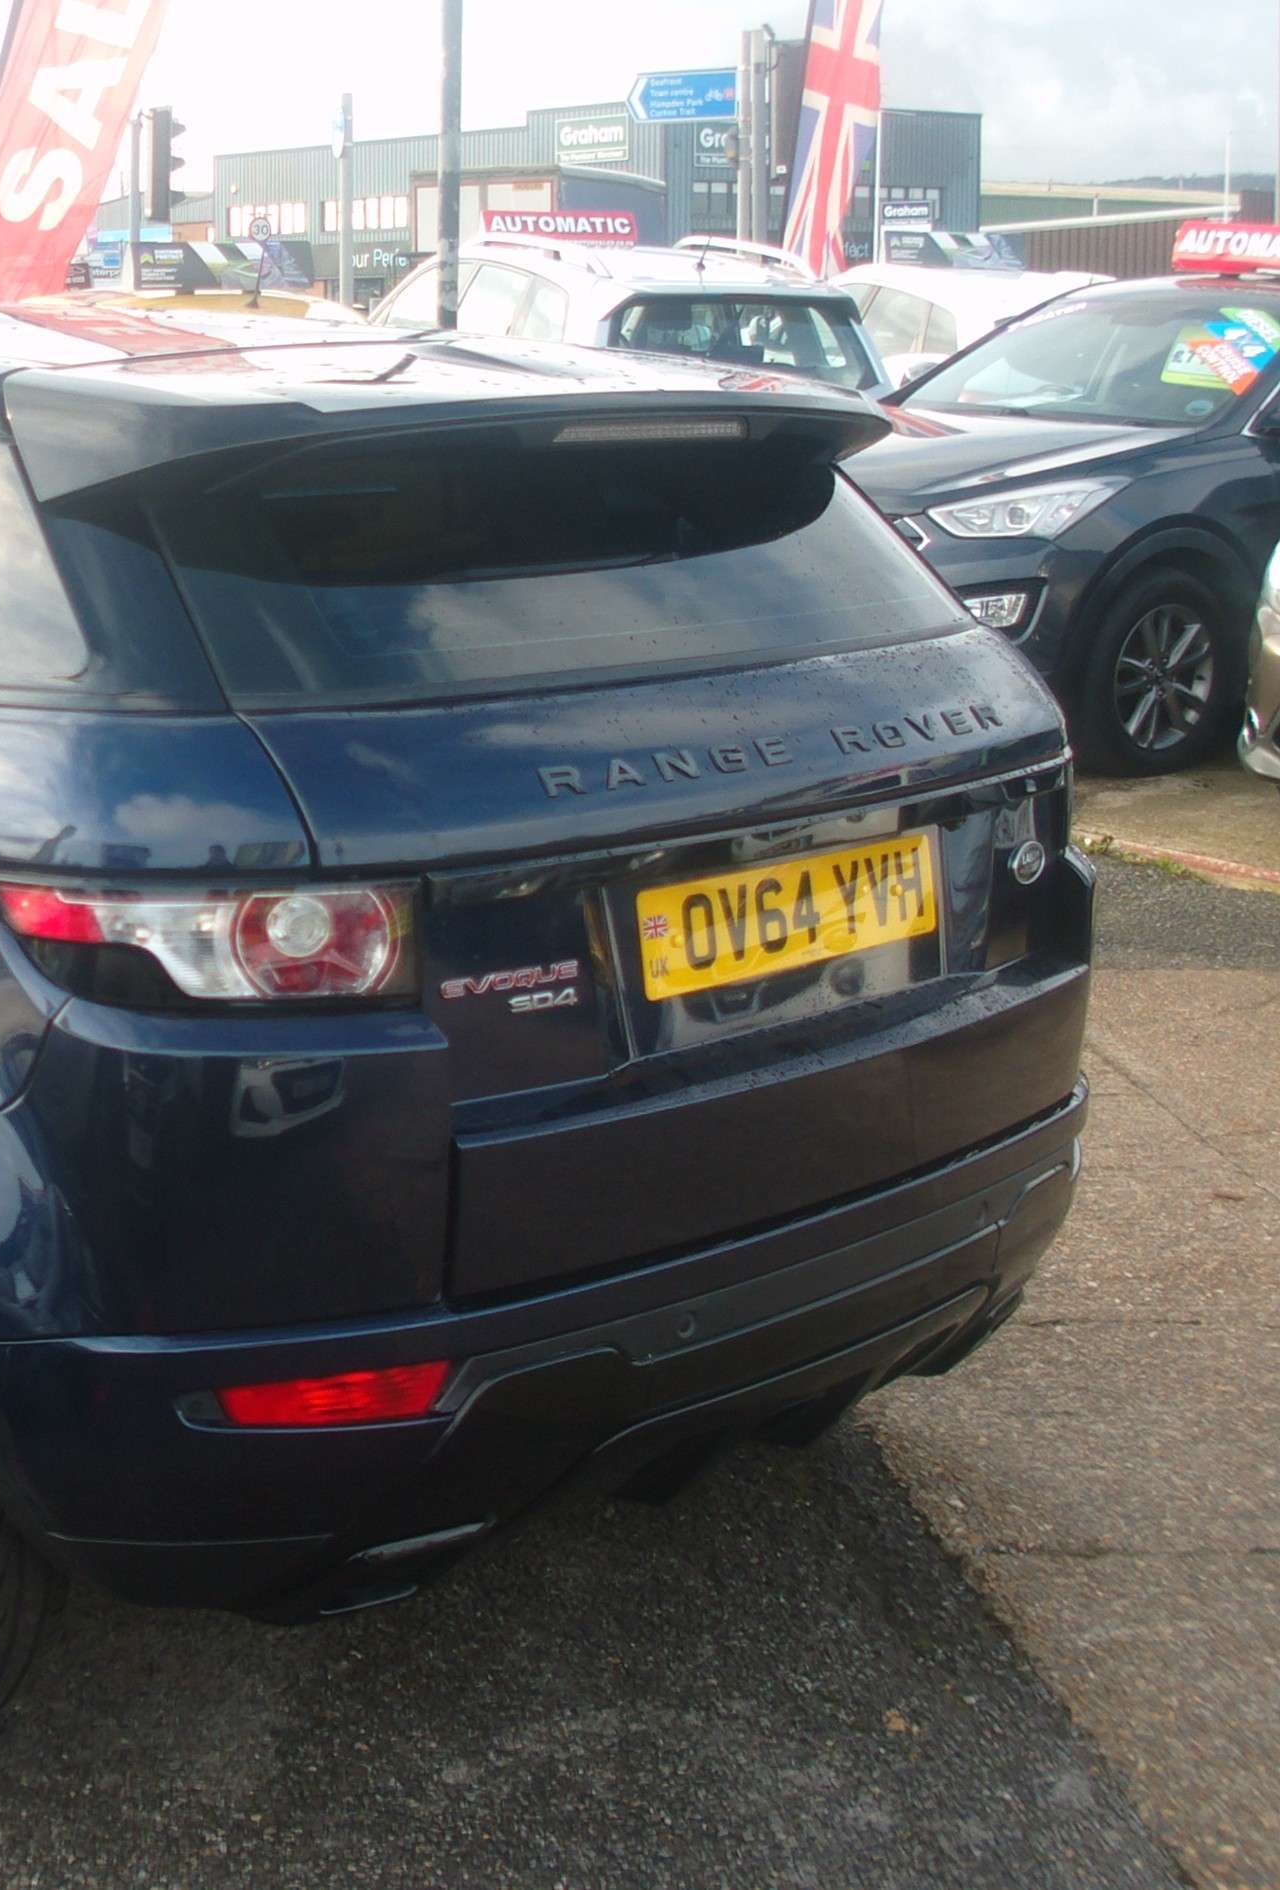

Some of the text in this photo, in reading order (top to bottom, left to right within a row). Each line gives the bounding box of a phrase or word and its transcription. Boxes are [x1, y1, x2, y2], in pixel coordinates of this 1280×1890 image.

[560, 125, 624, 147] Graham
[884, 205, 928, 217] Graham
[253, 224, 268, 235] 30
[490, 215, 632, 235] AUTOMATIC
[537, 703, 1005, 798] RANGE ROVER
[681, 847, 925, 971] OV64 YVH
[440, 959, 578, 999] EVOQUE
[649, 959, 670, 979] UK
[508, 987, 579, 1014] SD4
